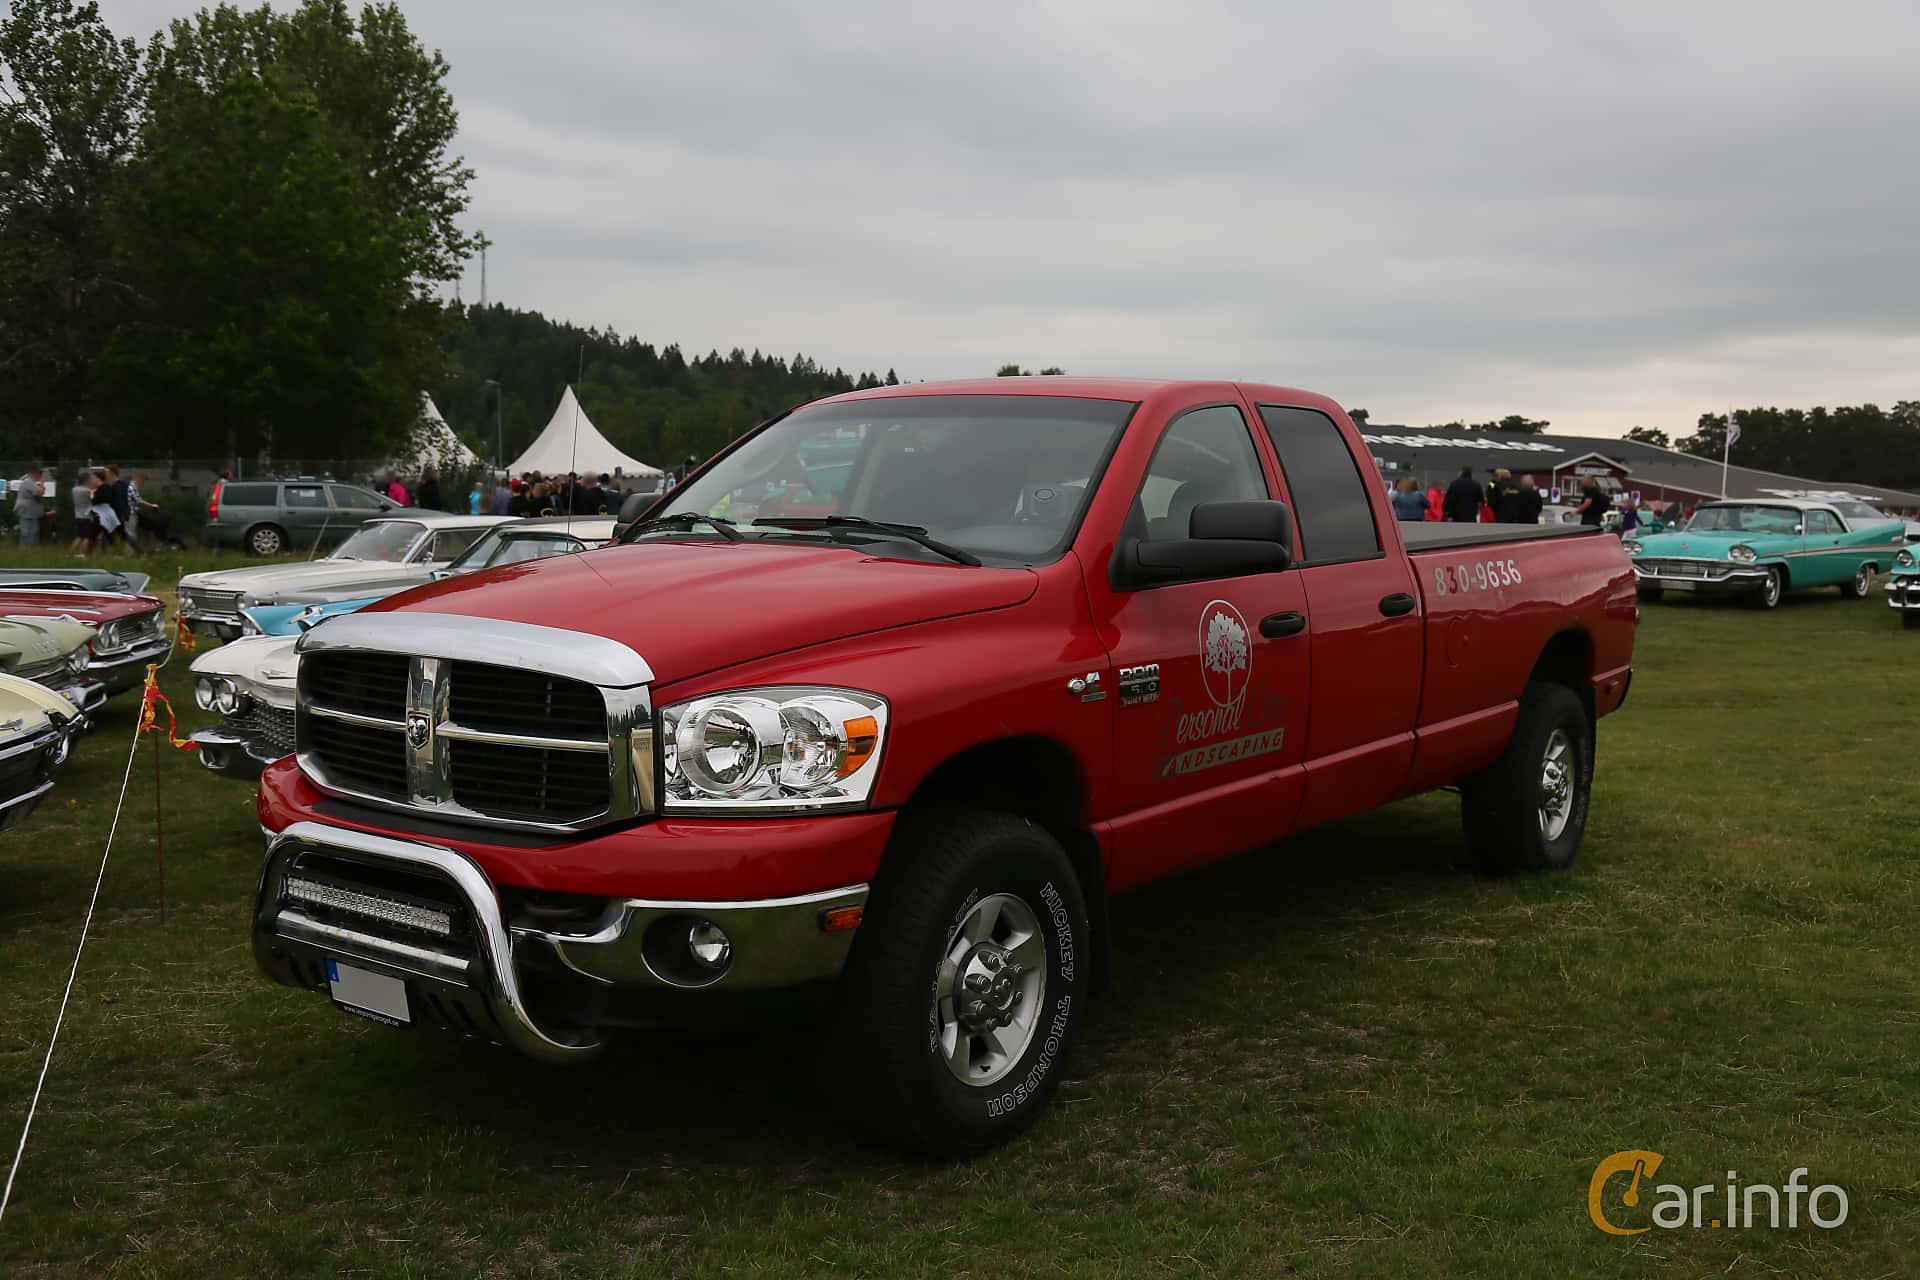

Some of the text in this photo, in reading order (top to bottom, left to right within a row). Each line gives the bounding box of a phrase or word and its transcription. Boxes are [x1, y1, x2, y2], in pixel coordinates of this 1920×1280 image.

[1434, 560, 1522, 597] 830-9636
[985, 881, 1075, 1118] MICKEY THOMPSON
